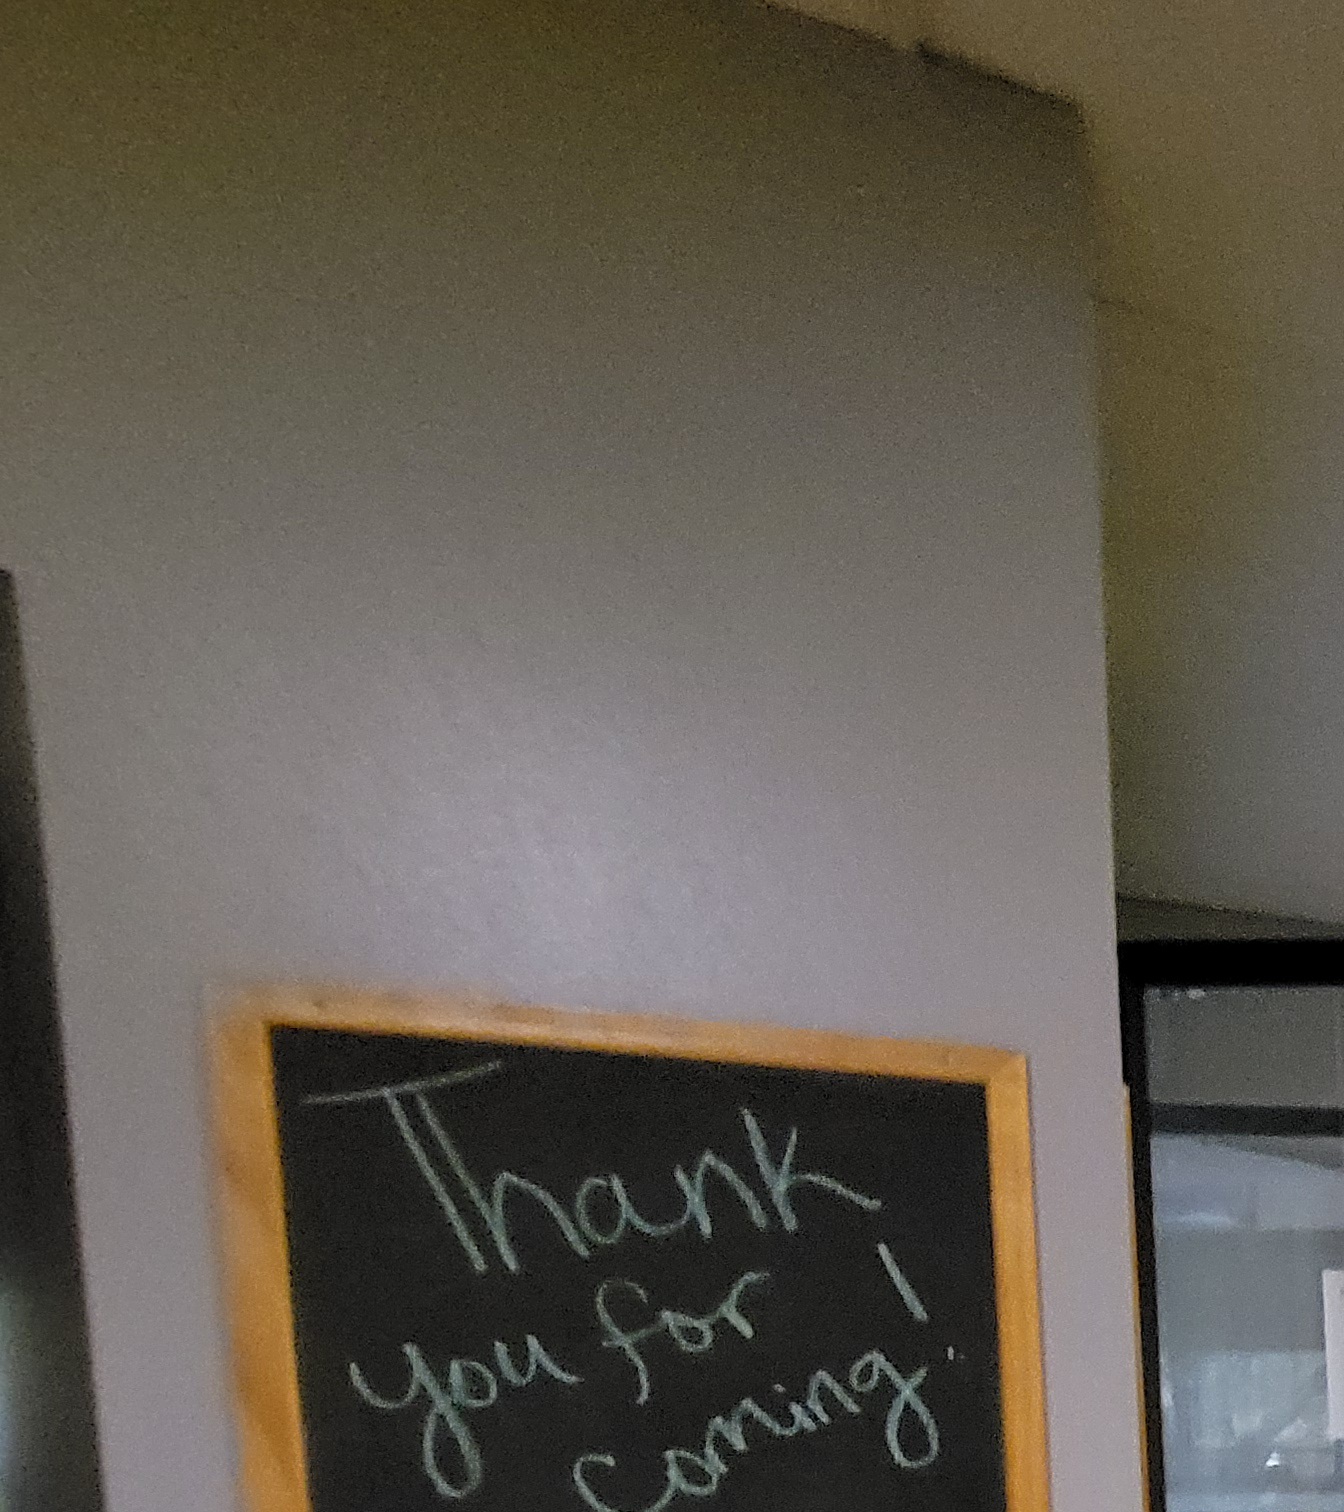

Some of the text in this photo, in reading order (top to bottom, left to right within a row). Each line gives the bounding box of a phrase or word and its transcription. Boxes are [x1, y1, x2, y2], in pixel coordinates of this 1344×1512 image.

[302, 1061, 882, 1273] Thank
[350, 1271, 769, 1499] you for
